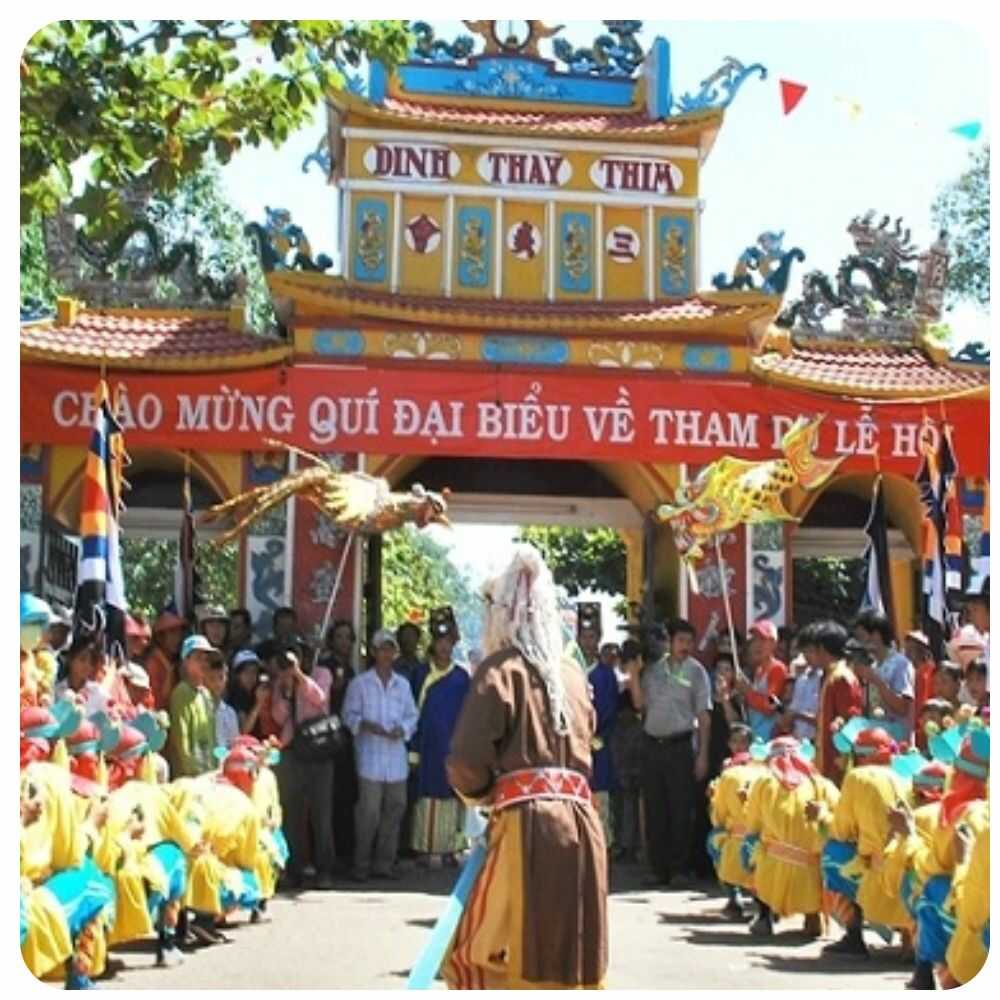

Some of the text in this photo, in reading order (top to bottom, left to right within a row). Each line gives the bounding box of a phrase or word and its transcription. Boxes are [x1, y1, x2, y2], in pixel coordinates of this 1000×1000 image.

[375, 144, 677, 193] DINH THAY THIM
[175, 385, 295, 433] MỪNG
[309, 387, 381, 444] QUÍ
[393, 398, 465, 445] ĐẠI
[478, 382, 571, 442] BIỂU
[583, 387, 635, 443] VỀ
[649, 408, 759, 450] THAM
[835, 405, 880, 456] LỄ
